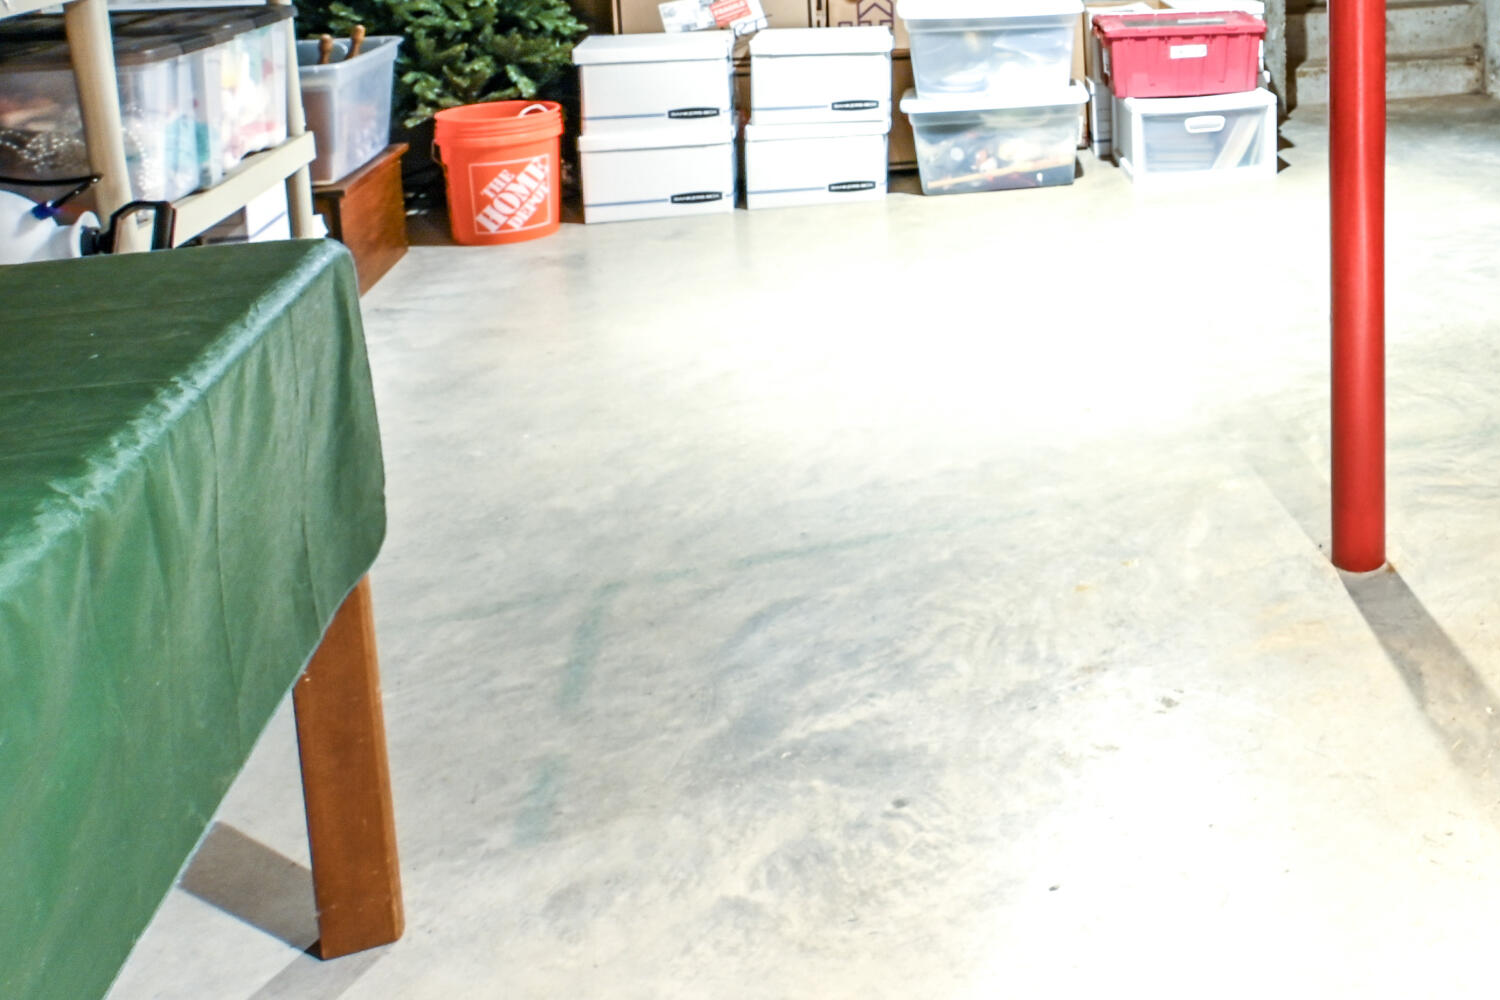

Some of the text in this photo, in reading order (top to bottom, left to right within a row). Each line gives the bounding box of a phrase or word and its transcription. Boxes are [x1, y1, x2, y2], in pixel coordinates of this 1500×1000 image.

[475, 157, 550, 233] HOME
[480, 168, 516, 200] THE
[507, 182, 550, 230] DEPOT
